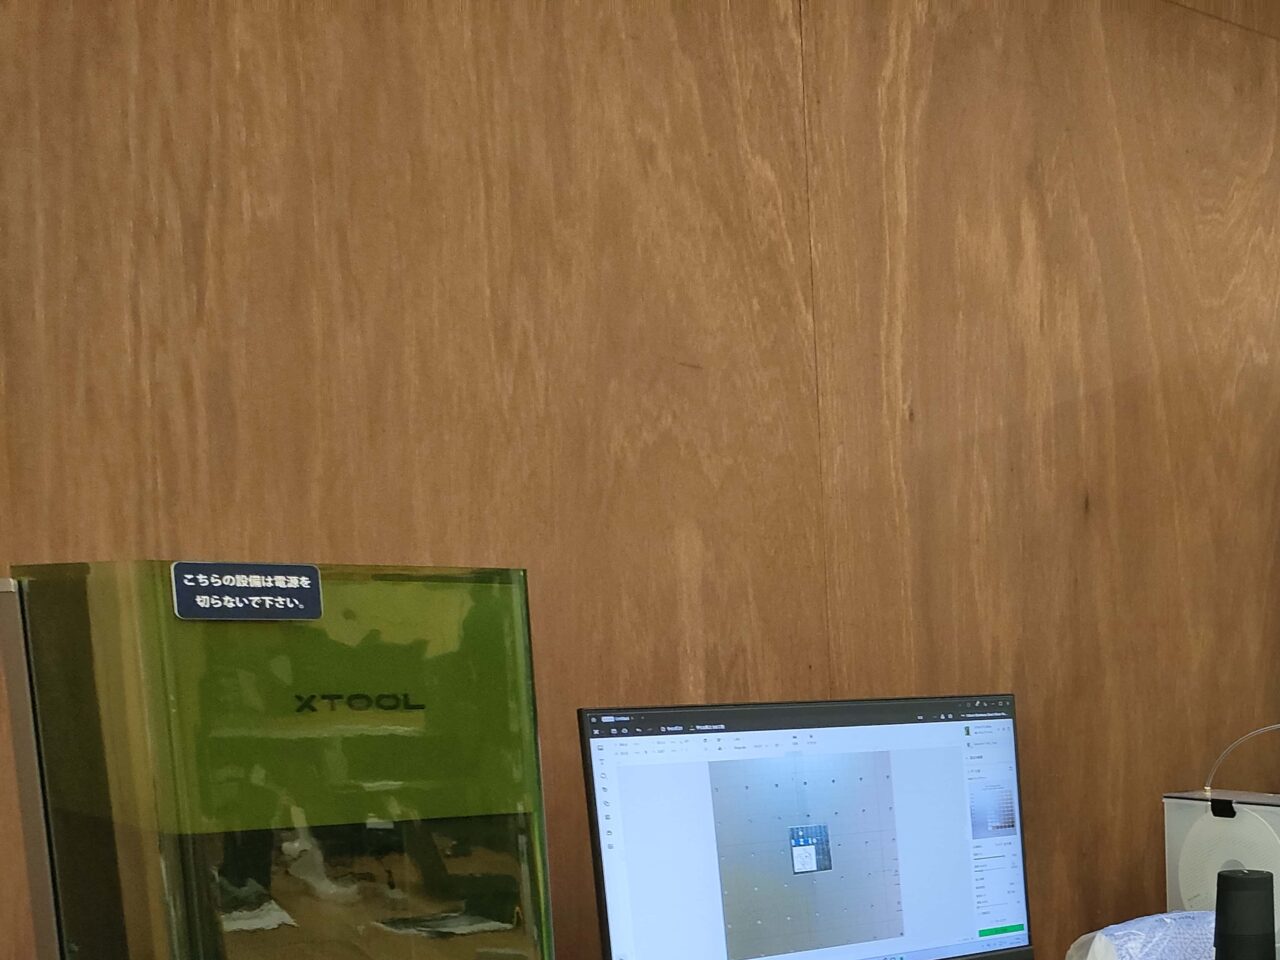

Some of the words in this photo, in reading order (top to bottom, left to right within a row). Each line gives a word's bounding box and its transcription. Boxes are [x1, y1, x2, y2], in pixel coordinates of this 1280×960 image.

[183, 574, 311, 588] こちらの設備は電源を
[195, 595, 305, 609] 切らないで下さい。
[294, 693, 426, 713] XTOOL
